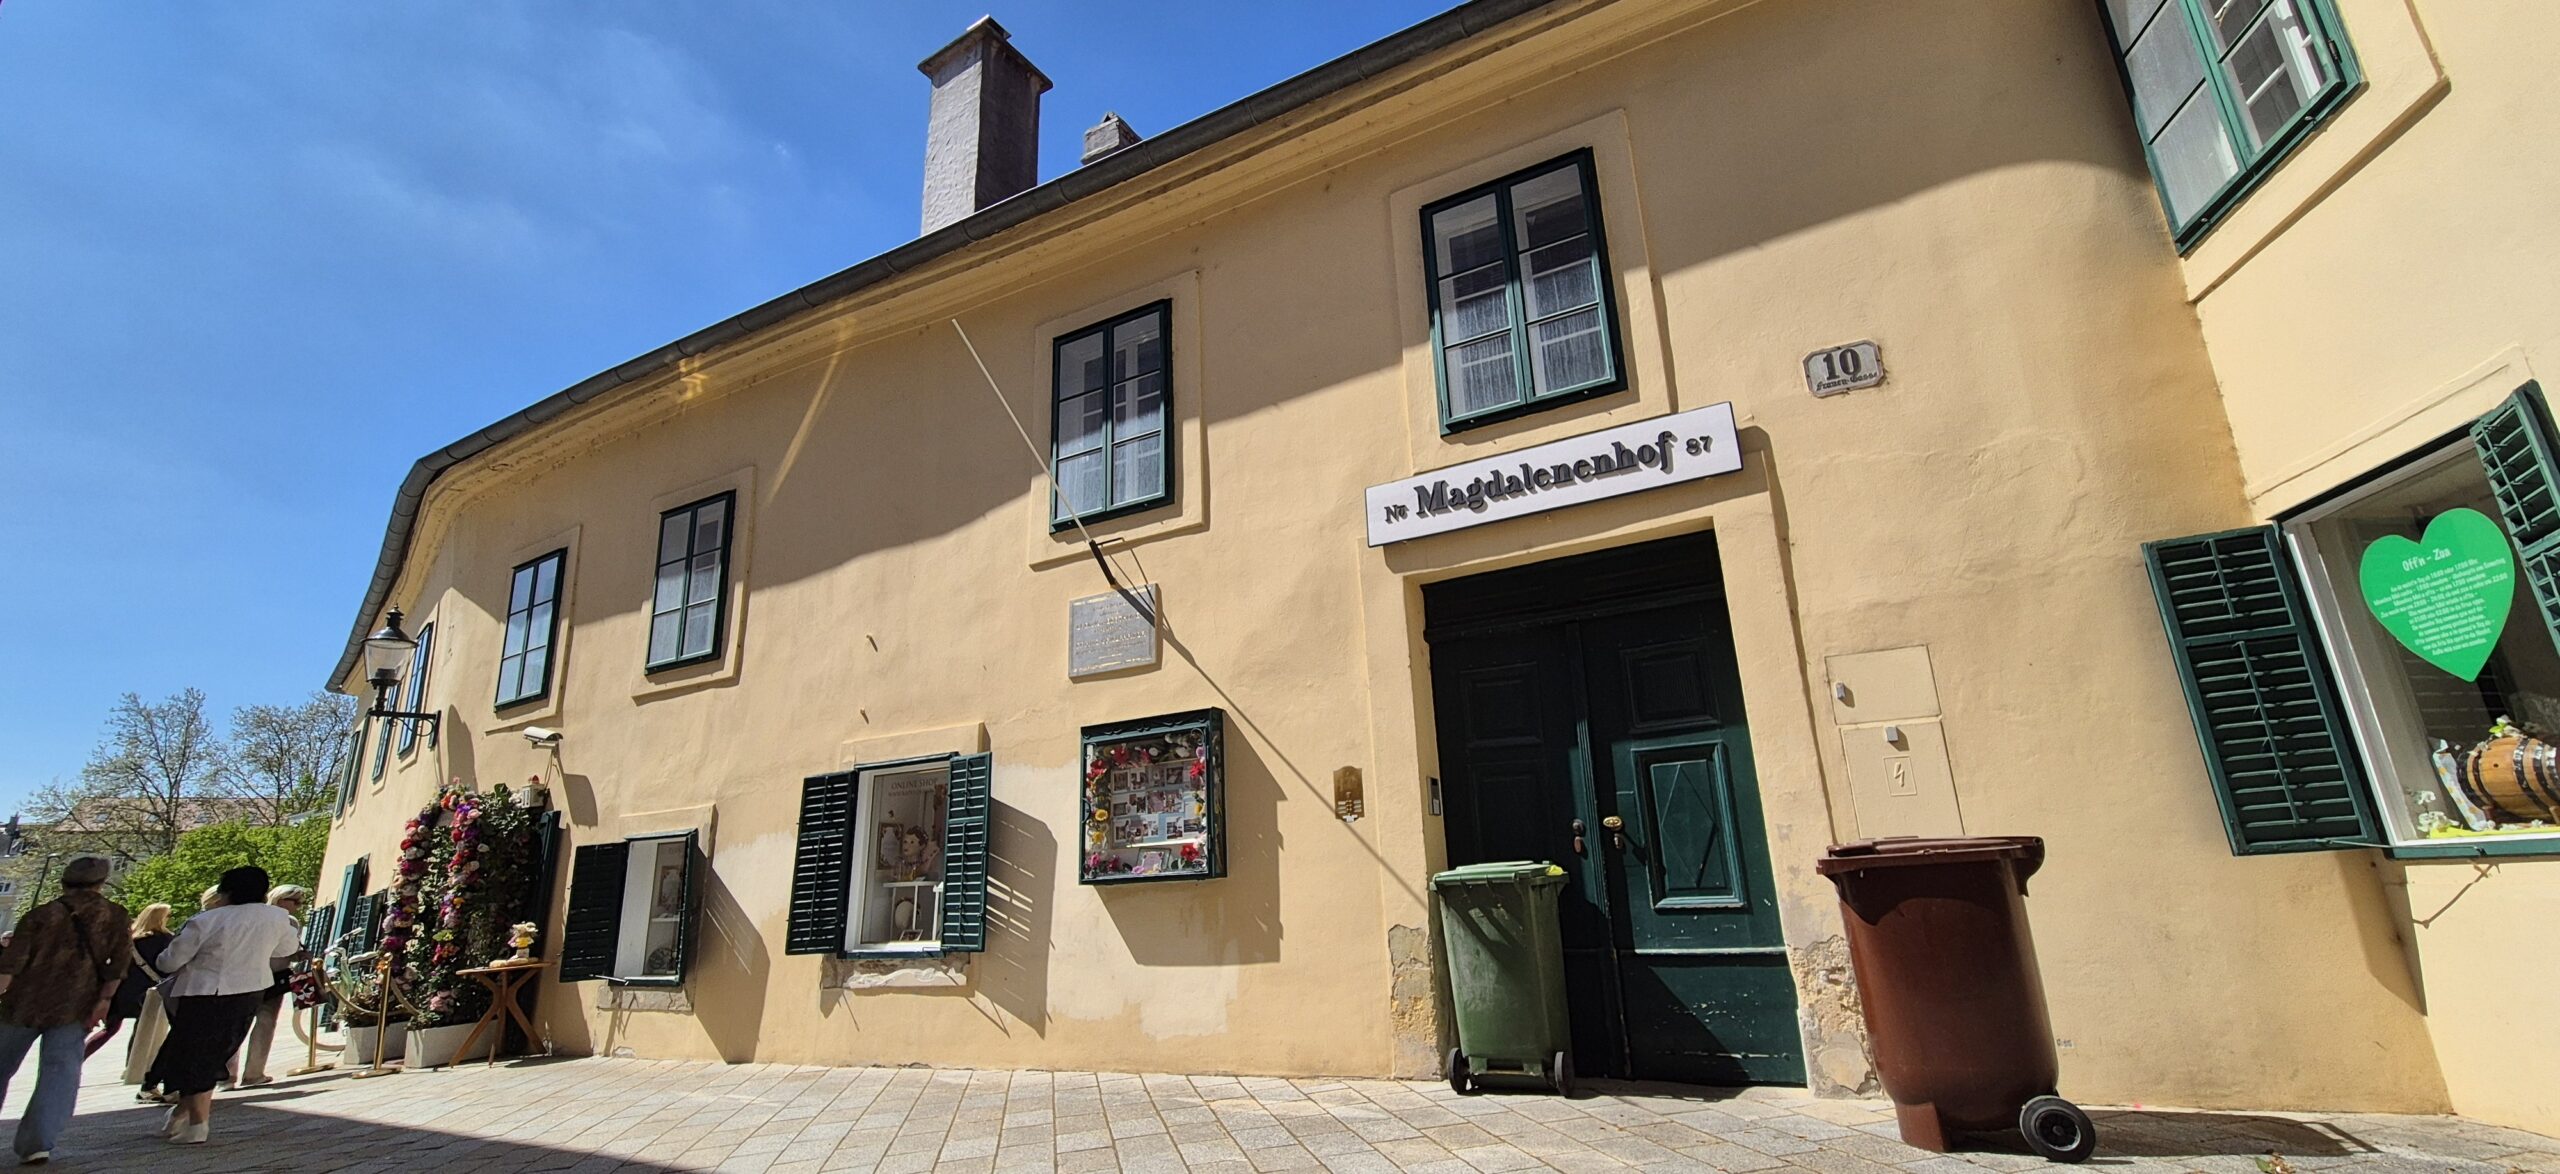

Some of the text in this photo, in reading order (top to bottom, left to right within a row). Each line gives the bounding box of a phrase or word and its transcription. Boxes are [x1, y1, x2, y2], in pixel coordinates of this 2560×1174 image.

[1823, 348, 1861, 380] 10
[1414, 431, 1675, 516] Magdalenenhof
[1686, 435, 1712, 455] 87
